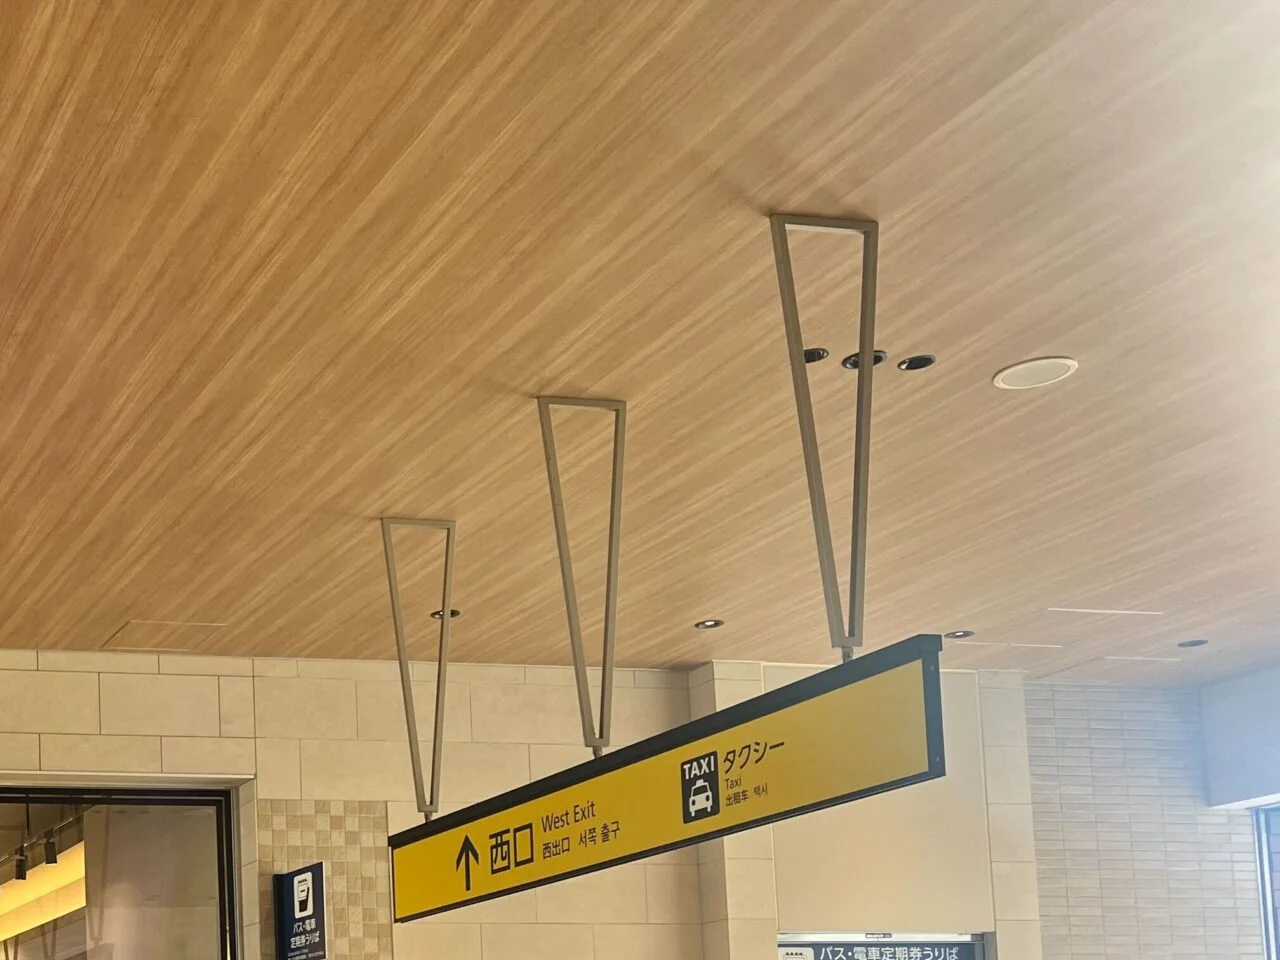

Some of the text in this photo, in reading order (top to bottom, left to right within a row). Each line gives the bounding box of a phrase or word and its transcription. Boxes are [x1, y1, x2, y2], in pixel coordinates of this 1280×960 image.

[683, 755, 715, 780] TAXI
[723, 741, 785, 774] タクシー
[725, 777, 742, 791] Taxi
[541, 800, 596, 833] West Exit
[488, 822, 534, 875] 西口
[542, 820, 620, 861] 西出口 서쪽 출구
